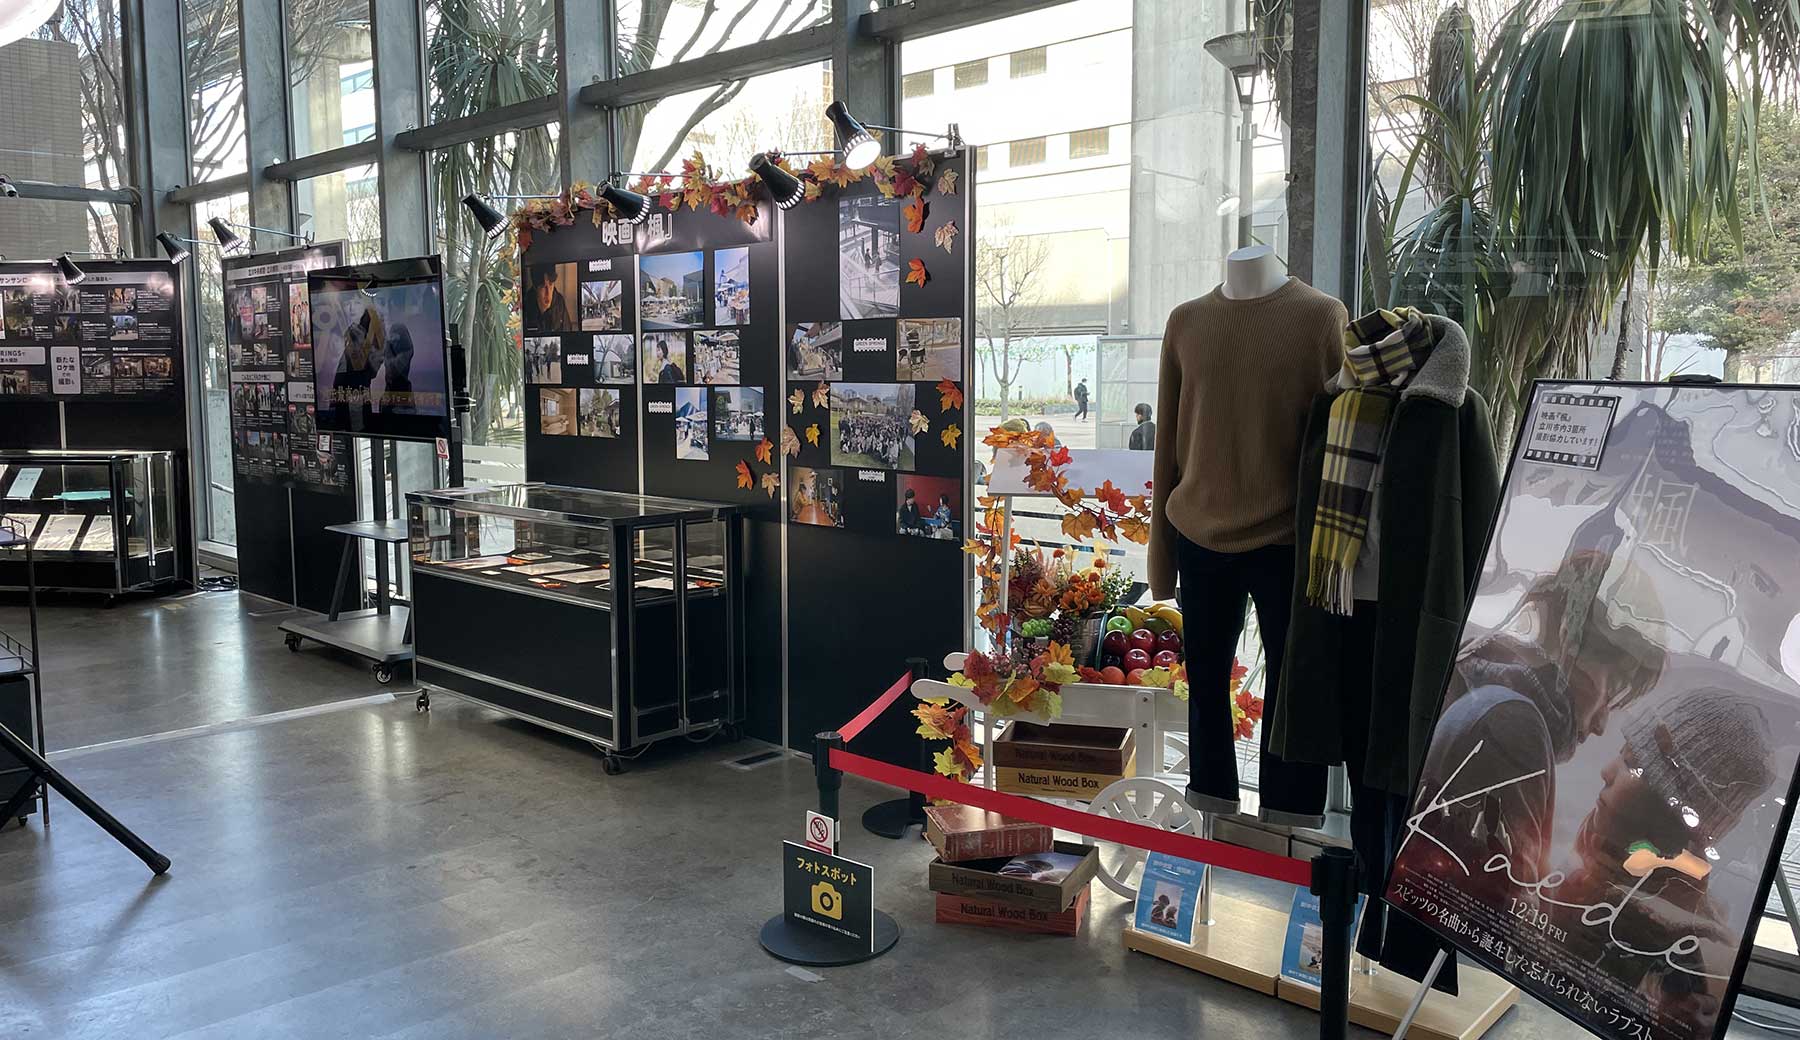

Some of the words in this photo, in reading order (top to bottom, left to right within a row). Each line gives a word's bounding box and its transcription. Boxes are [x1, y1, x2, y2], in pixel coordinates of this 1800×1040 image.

[1018, 772, 1049, 785] Natural
[1052, 775, 1079, 787] Wood
[1082, 777, 1100, 789] Box
[1396, 740, 1730, 980] Kaede
[796, 857, 857, 886] フォトスポット
[952, 872, 984, 889] Natural
[985, 878, 1014, 894] Wood
[1016, 883, 1035, 897] Box
[960, 902, 994, 918] Natural
[996, 904, 1026, 919] Wood
[1028, 907, 1048, 921] Box
[1547, 924, 1568, 943] FRI
